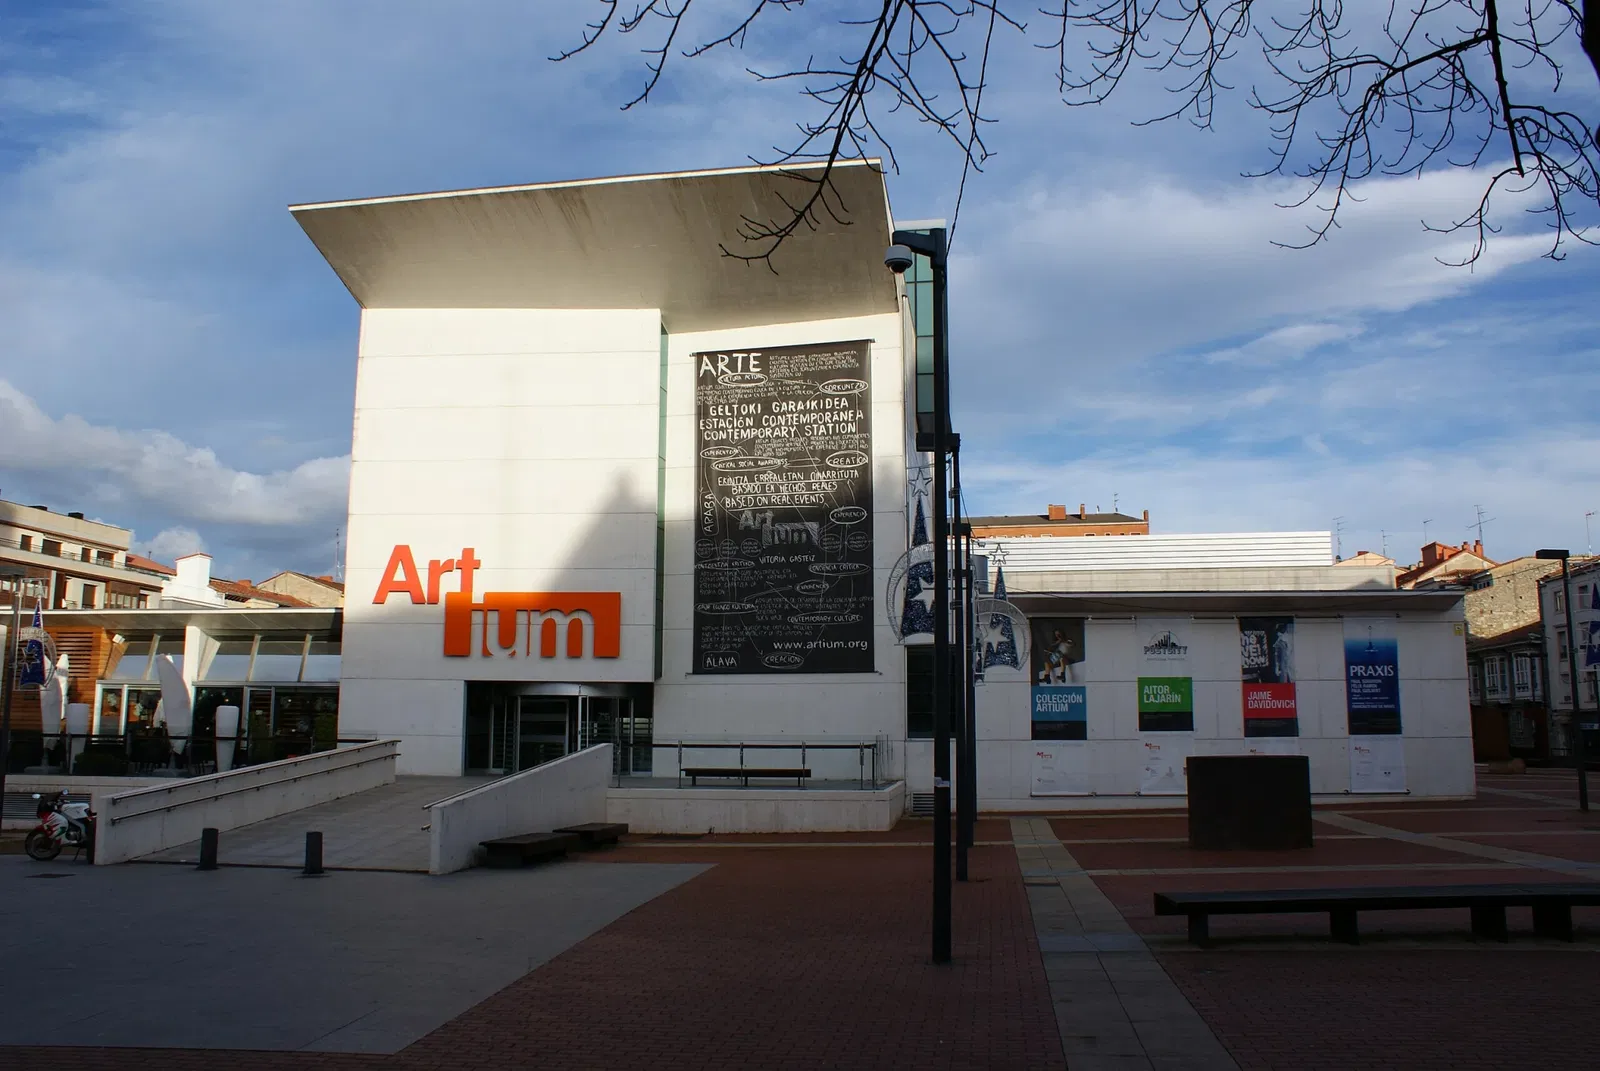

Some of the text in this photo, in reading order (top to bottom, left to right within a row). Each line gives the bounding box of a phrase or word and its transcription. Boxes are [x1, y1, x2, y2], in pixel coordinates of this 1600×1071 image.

[699, 353, 762, 378] ARTE
[709, 397, 849, 417] GELTOKI GARAIKIDEA
[699, 410, 864, 430] ESTACIÓN CONTEMPORÁNEA
[704, 426, 797, 442] CONTEMPORARY
[804, 422, 856, 437] STATION
[732, 484, 761, 495] BASADO
[780, 483, 806, 493] HECHOS
[812, 482, 838, 491] REALES
[725, 493, 825, 508] BASED ON REAL EVENTS
[704, 493, 716, 533] ARABA
[759, 551, 816, 565] VITORIA GASTEIZ
[787, 614, 832, 624] CONTEMPORARY
[833, 613, 863, 623] CULTURE
[772, 639, 869, 651] www.artium.org
[1350, 664, 1395, 677] PRAXIS
[1143, 685, 1170, 695] AITOR
[1247, 691, 1272, 700] JAIME
[1035, 692, 1083, 704] COLECCIÓN
[1143, 692, 1182, 704] LAJARÍN
[1248, 699, 1295, 709] DAVIDOVICH
[1035, 703, 1069, 712] ARTIUM
